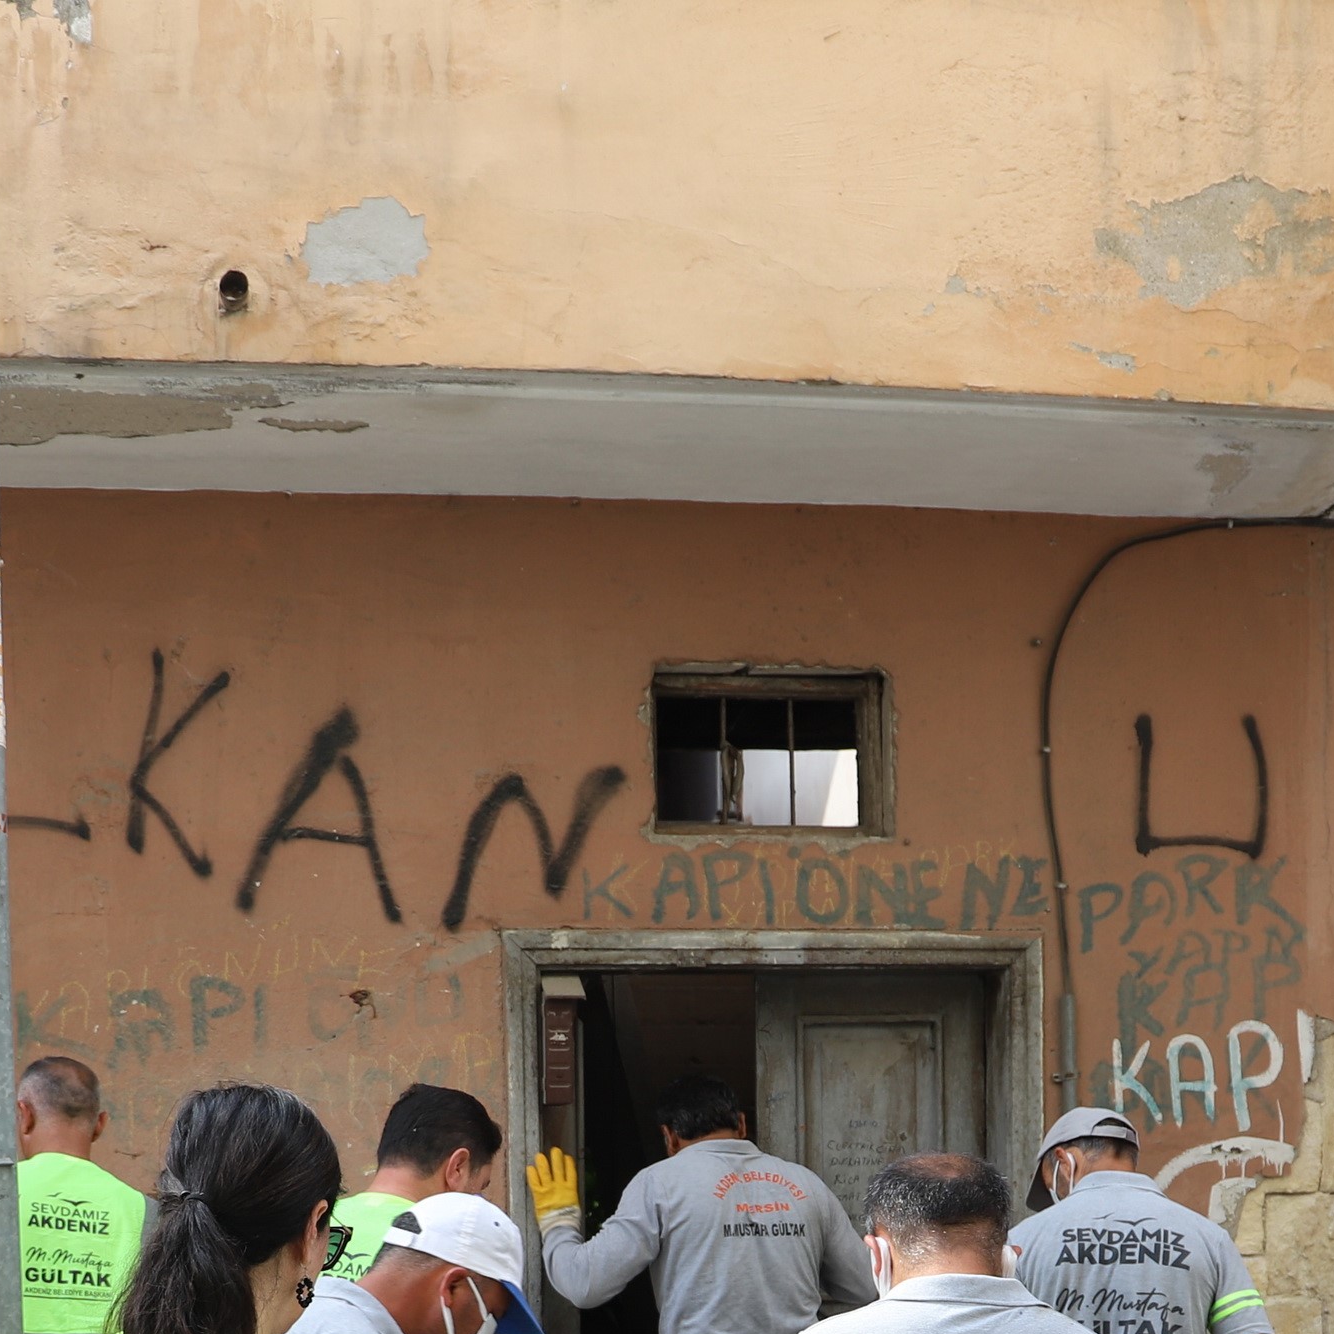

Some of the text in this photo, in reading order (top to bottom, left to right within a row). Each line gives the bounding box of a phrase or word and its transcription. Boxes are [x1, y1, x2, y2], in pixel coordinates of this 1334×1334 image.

[1077, 853, 1307, 954] PARK
[31, 1202, 110, 1221] SEVDAMIZ
[736, 1201, 791, 1216] MERSİN
[1062, 1228, 1185, 1248] SEVDAMIZ
[1055, 1243, 1191, 1271] AKDENİZ
[24, 1267, 112, 1287] GÜLTAK
